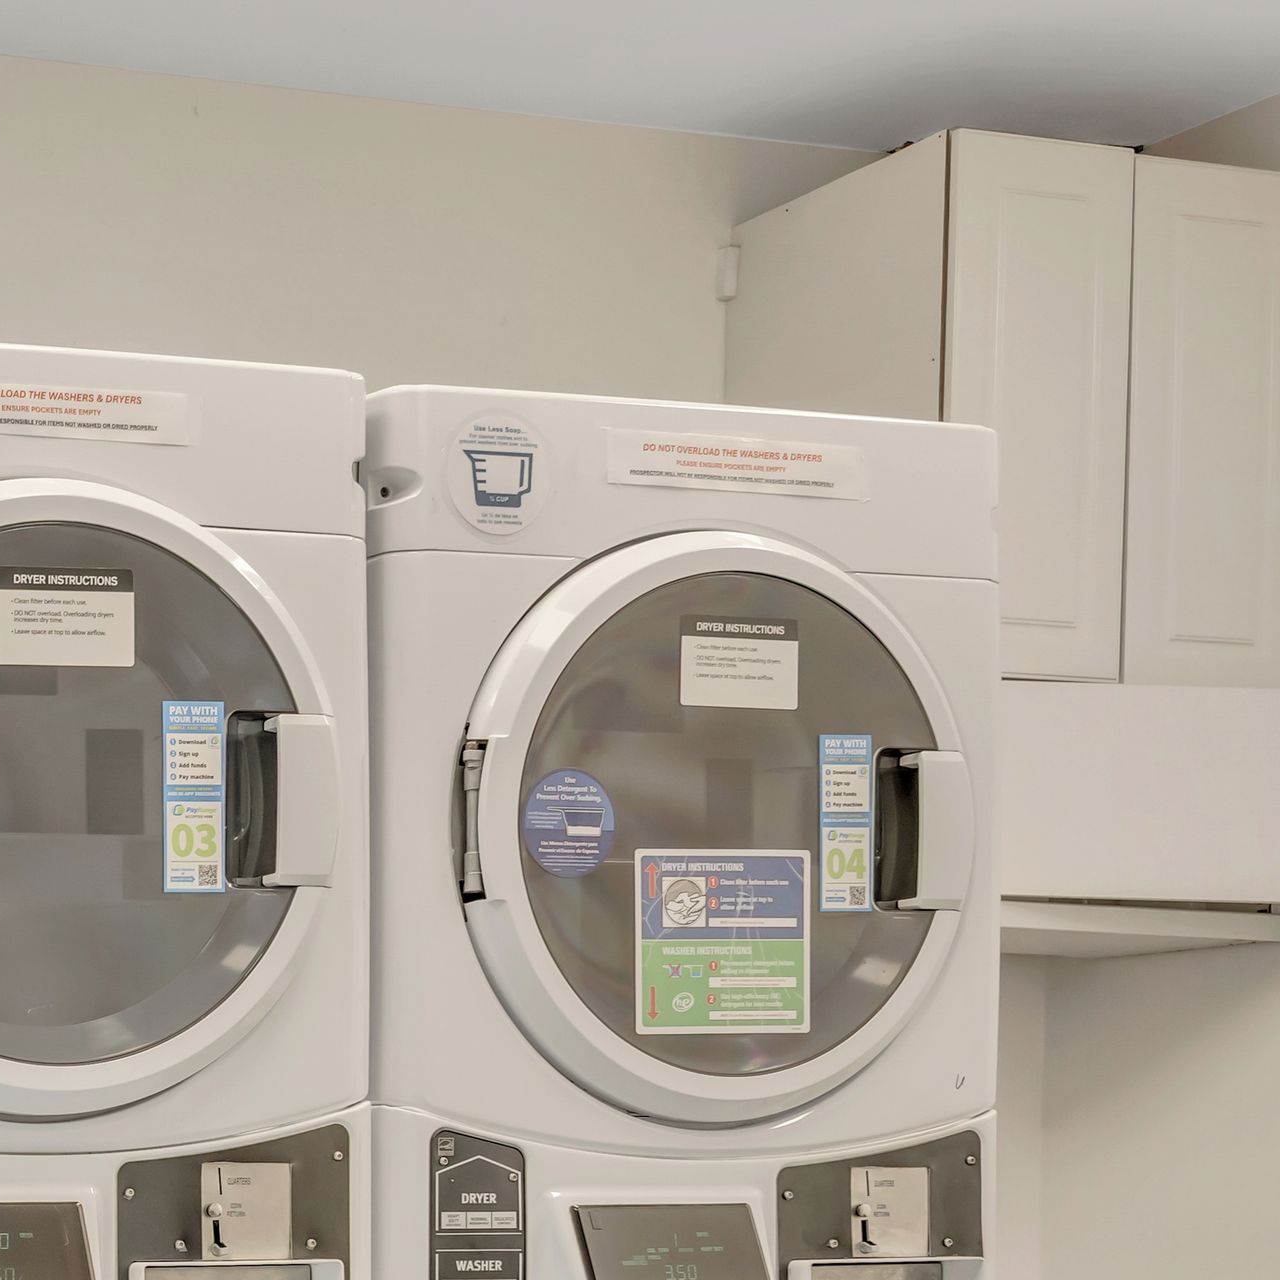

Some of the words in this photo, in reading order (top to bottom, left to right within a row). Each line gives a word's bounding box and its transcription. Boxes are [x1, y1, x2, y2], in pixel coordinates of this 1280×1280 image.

[29, 390, 46, 400] THE
[48, 392, 95, 403] WASHERS
[96, 394, 103, 402] &
[106, 394, 143, 405] DRYERS
[643, 443, 656, 452] DO
[658, 444, 676, 453] NOT
[677, 446, 720, 456] OVERLOAD
[722, 449, 738, 457] THE
[740, 450, 780, 460] WASHERS
[782, 453, 788, 461] &
[790, 453, 823, 463] DRYERS
[13, 574, 46, 585] DRYER
[48, 575, 118, 586] INSTRUCTIONS
[696, 622, 724, 632] DRYER
[726, 624, 785, 635] INSTRUCTIONS
[172, 823, 217, 858] 03
[826, 848, 866, 880] 04
[461, 1193, 497, 1204] DRYER
[456, 1260, 502, 1272] WASHER
